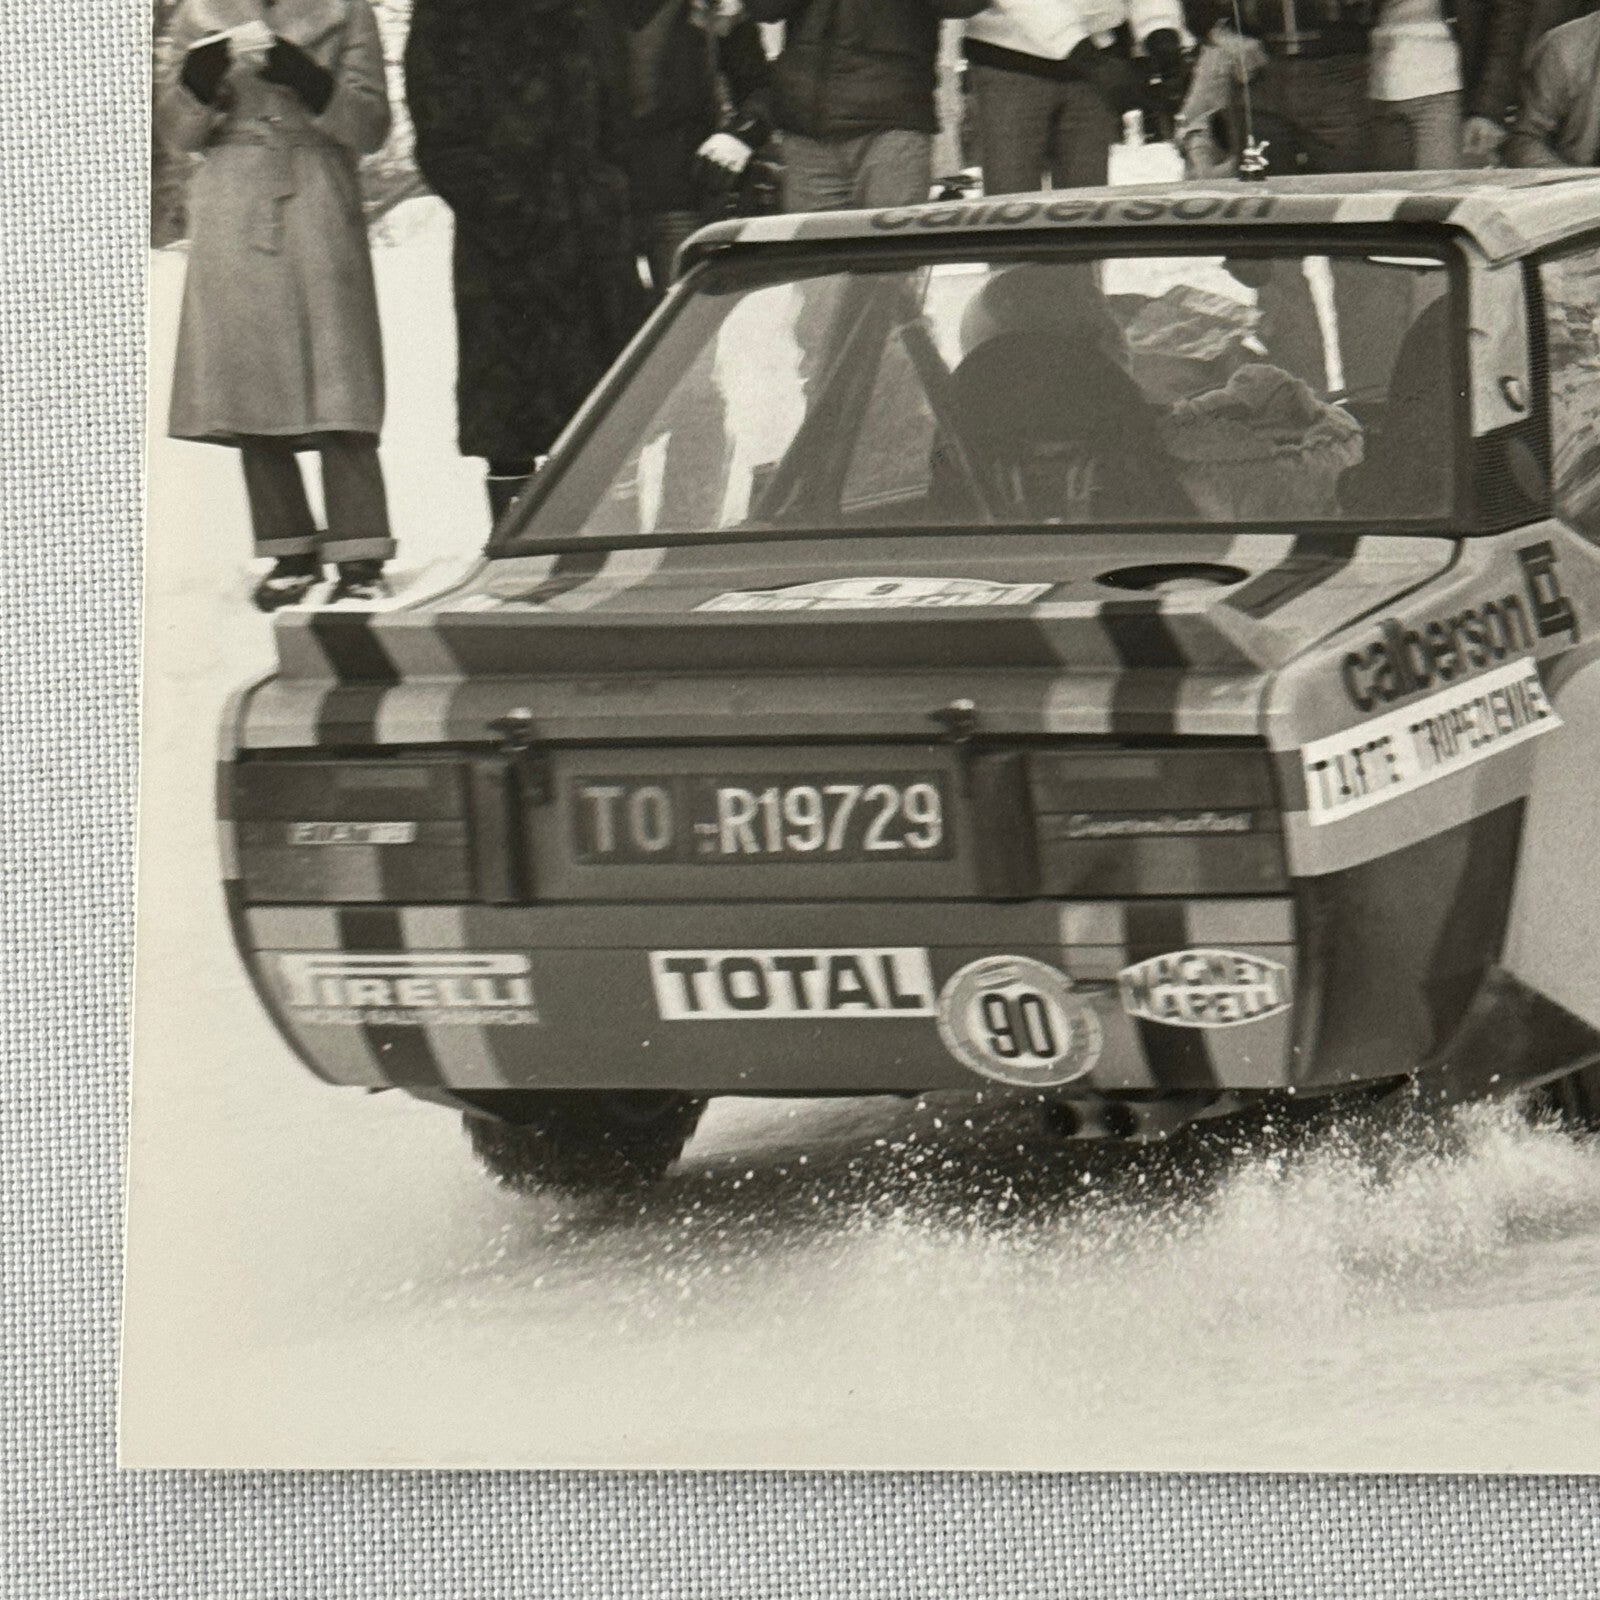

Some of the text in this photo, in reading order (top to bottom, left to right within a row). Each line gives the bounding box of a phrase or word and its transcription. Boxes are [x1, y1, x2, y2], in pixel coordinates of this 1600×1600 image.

[871, 197, 1273, 230] calberson
[1341, 593, 1536, 713] calberson
[584, 785, 674, 852] TO
[278, 954, 535, 1006] PIRELLI
[664, 954, 925, 1012] TOTAL
[982, 993, 1056, 1059] 90
